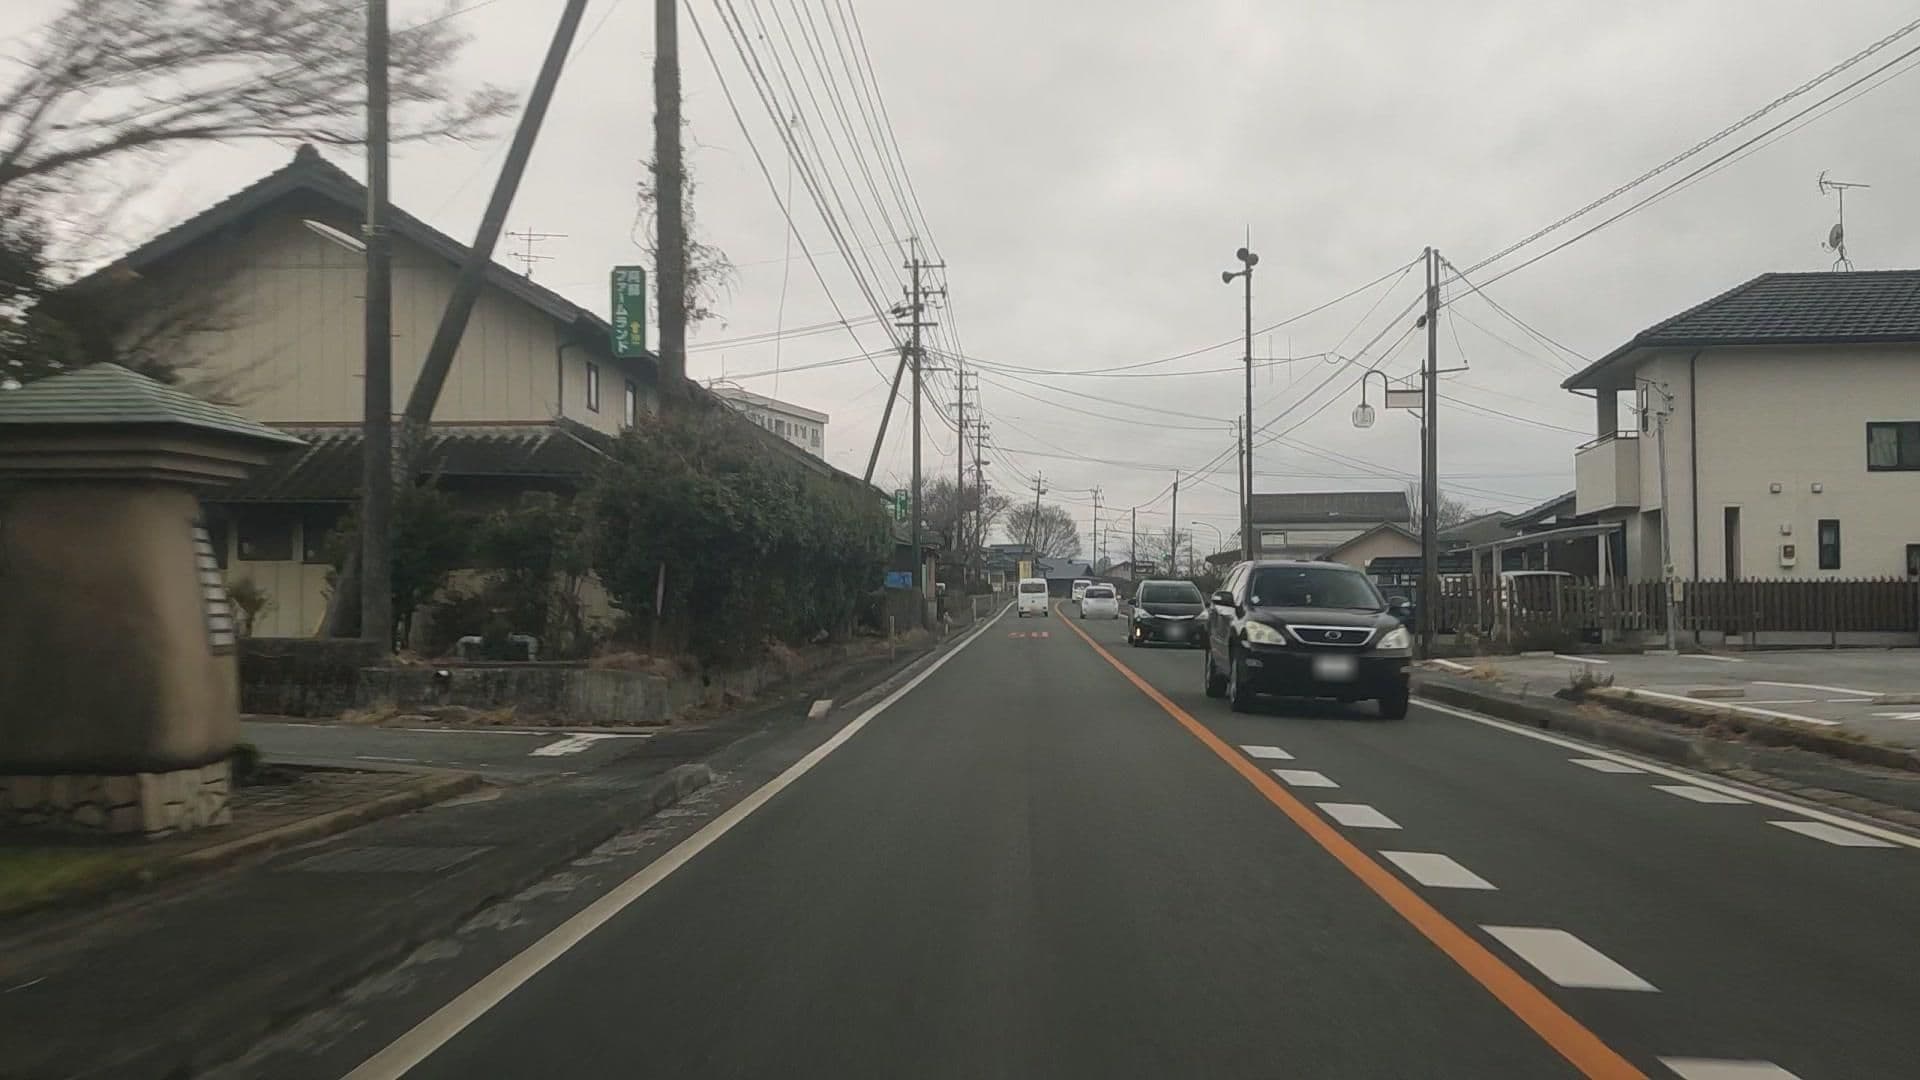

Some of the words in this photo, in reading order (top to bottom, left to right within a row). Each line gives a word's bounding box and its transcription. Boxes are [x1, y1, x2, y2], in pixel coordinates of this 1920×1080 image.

[615, 270, 628, 353] ファームランド
